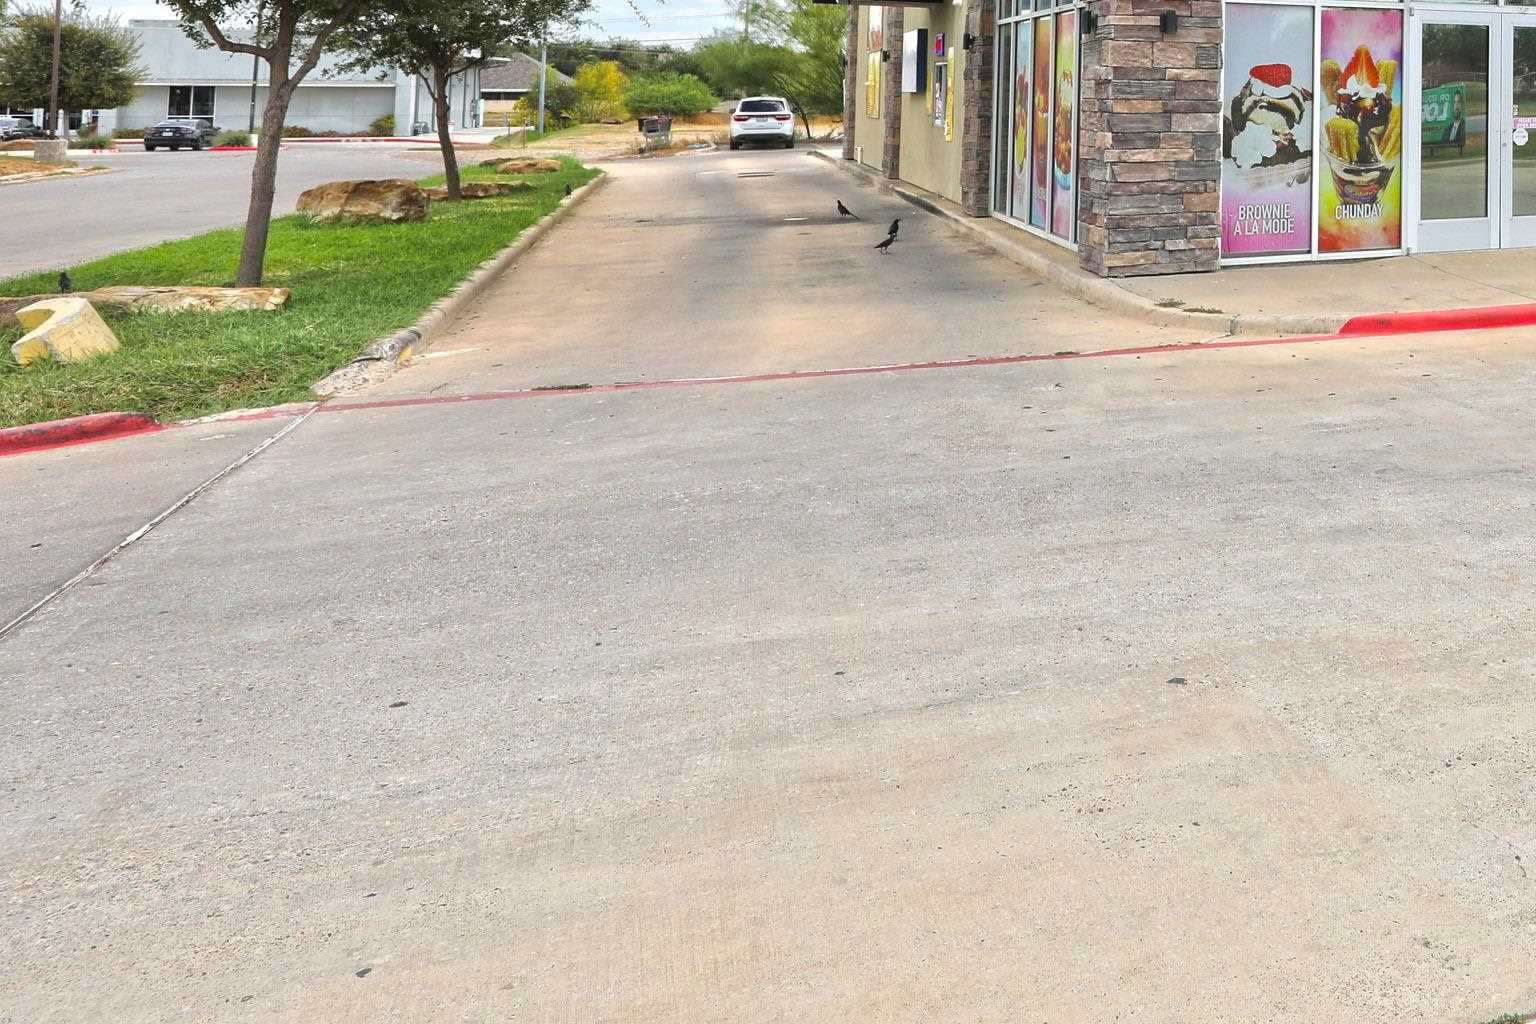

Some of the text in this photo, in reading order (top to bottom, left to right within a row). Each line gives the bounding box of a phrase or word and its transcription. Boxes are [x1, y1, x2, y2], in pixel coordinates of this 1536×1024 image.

[1238, 204, 1291, 220] BROWNIE
[1335, 203, 1383, 220] CHUNDAY
[1234, 218, 1295, 236] A LA MODE
